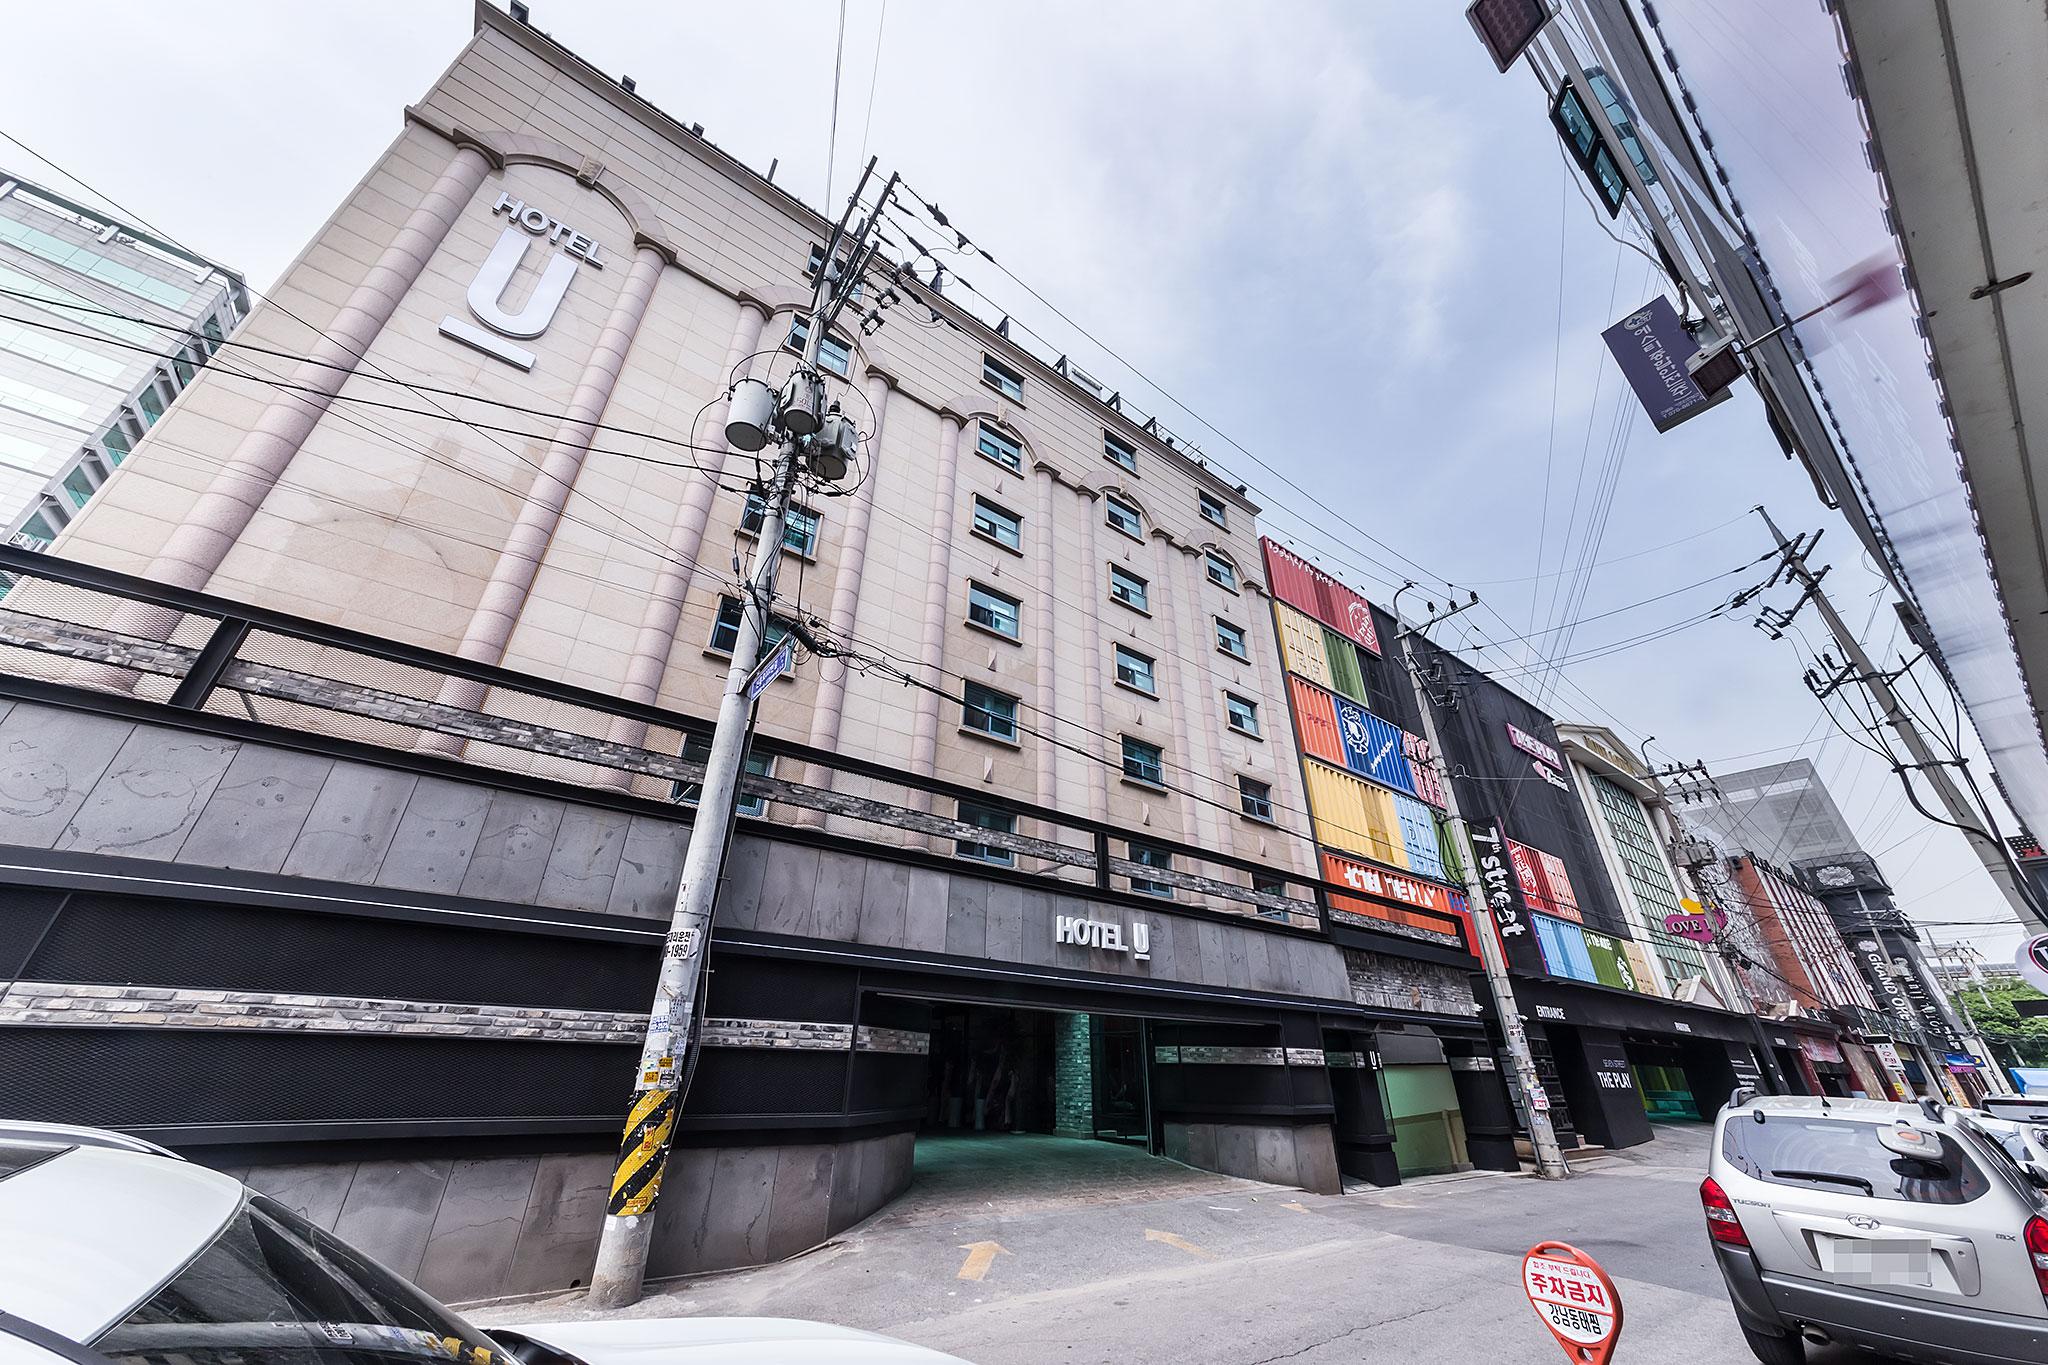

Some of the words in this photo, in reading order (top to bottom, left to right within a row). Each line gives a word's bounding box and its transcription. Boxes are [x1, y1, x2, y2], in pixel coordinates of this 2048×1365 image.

[491, 190, 605, 270] HOTEL
[466, 226, 579, 341] U
[1056, 915, 1129, 952] HOTEL
[1132, 922, 1150, 954] U
[1868, 953, 1898, 994] GRAND
[1535, 1005, 1566, 1020] ENTRANCE
[1597, 1071, 1615, 1088] THE
[1612, 1072, 1632, 1089] PLAY
[1530, 1272, 1606, 1308] 주차금지
